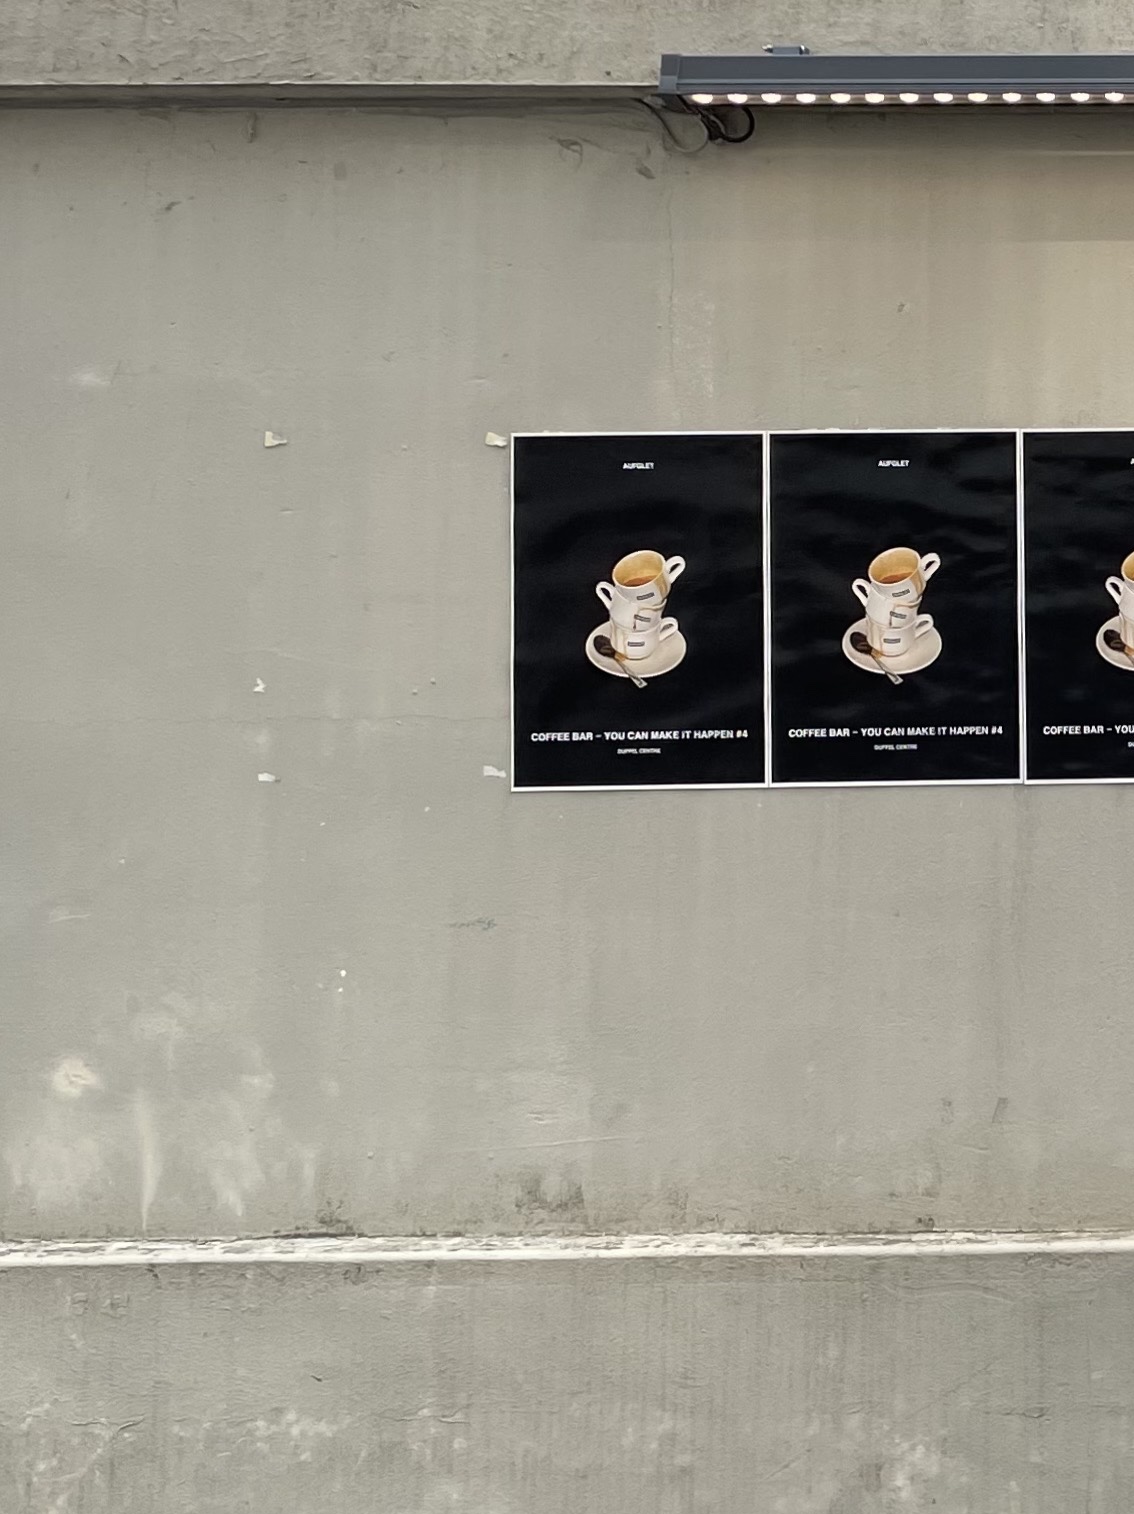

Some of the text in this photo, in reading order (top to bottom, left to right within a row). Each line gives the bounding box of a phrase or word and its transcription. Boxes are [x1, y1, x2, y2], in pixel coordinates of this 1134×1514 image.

[531, 732, 570, 741] COFFEE
[572, 732, 593, 741] BAR
[604, 731, 625, 741] YOU
[627, 731, 649, 740] CAN
[650, 731, 679, 740] MAKE
[681, 730, 692, 739] IT
[694, 730, 734, 739] HAPPEN
[736, 730, 748, 738] #4
[788, 728, 827, 738] COFFEE
[829, 728, 850, 737] BAR
[861, 728, 882, 737] YOU
[884, 727, 905, 736] CAN
[907, 727, 936, 736] MAKE
[938, 727, 947, 735] IT
[950, 726, 988, 735] HAPPEN
[991, 726, 1003, 734] #4
[1043, 726, 1081, 735] COFFEE
[1083, 725, 1104, 734] BAR
[1115, 725, 1134, 734] YOU
